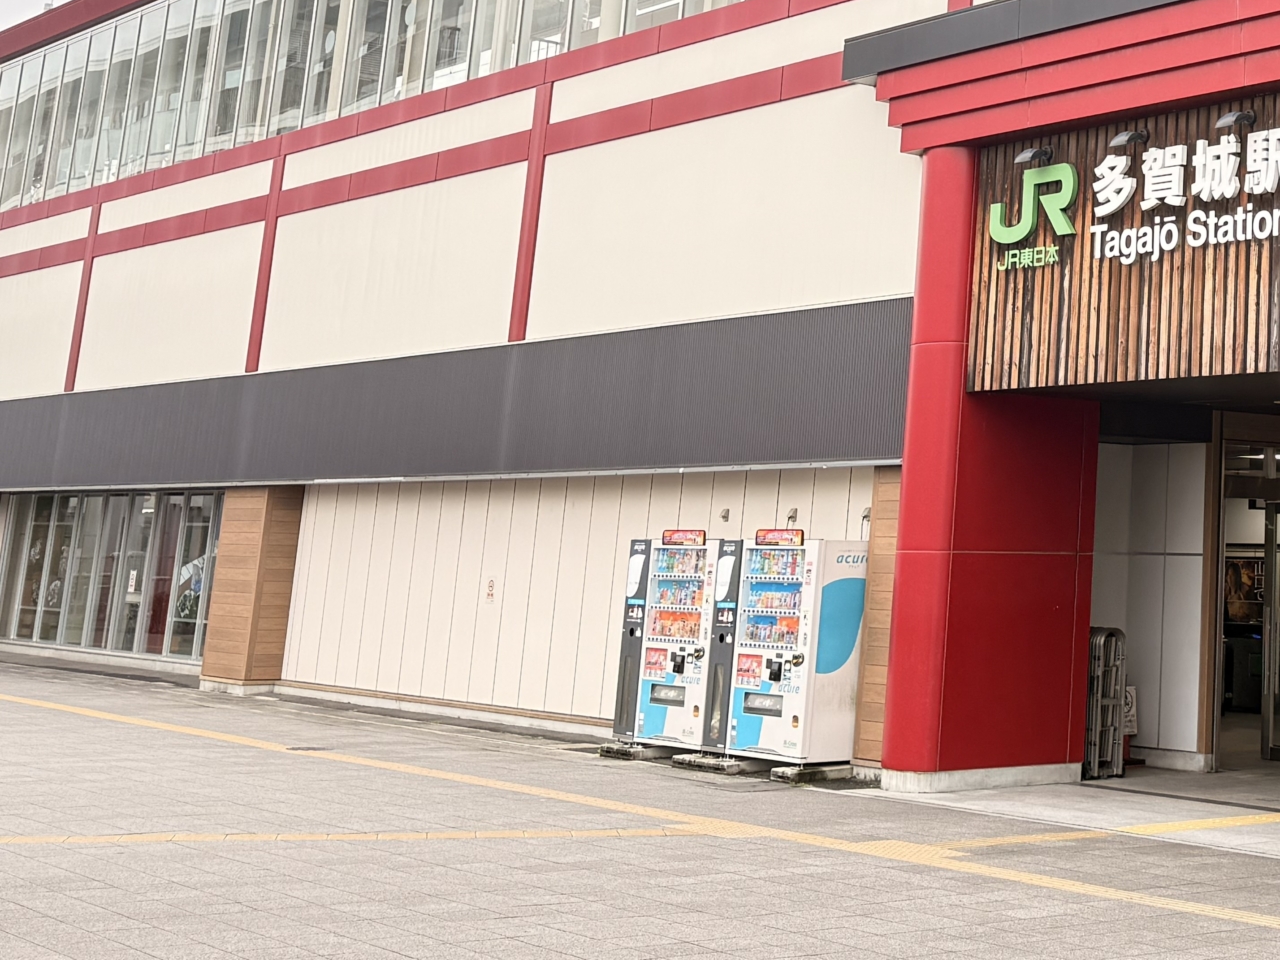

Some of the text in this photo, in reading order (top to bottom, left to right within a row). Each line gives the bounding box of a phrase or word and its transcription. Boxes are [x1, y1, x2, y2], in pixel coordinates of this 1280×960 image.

[989, 162, 1079, 244] JR
[997, 243, 1060, 271] JR東日本
